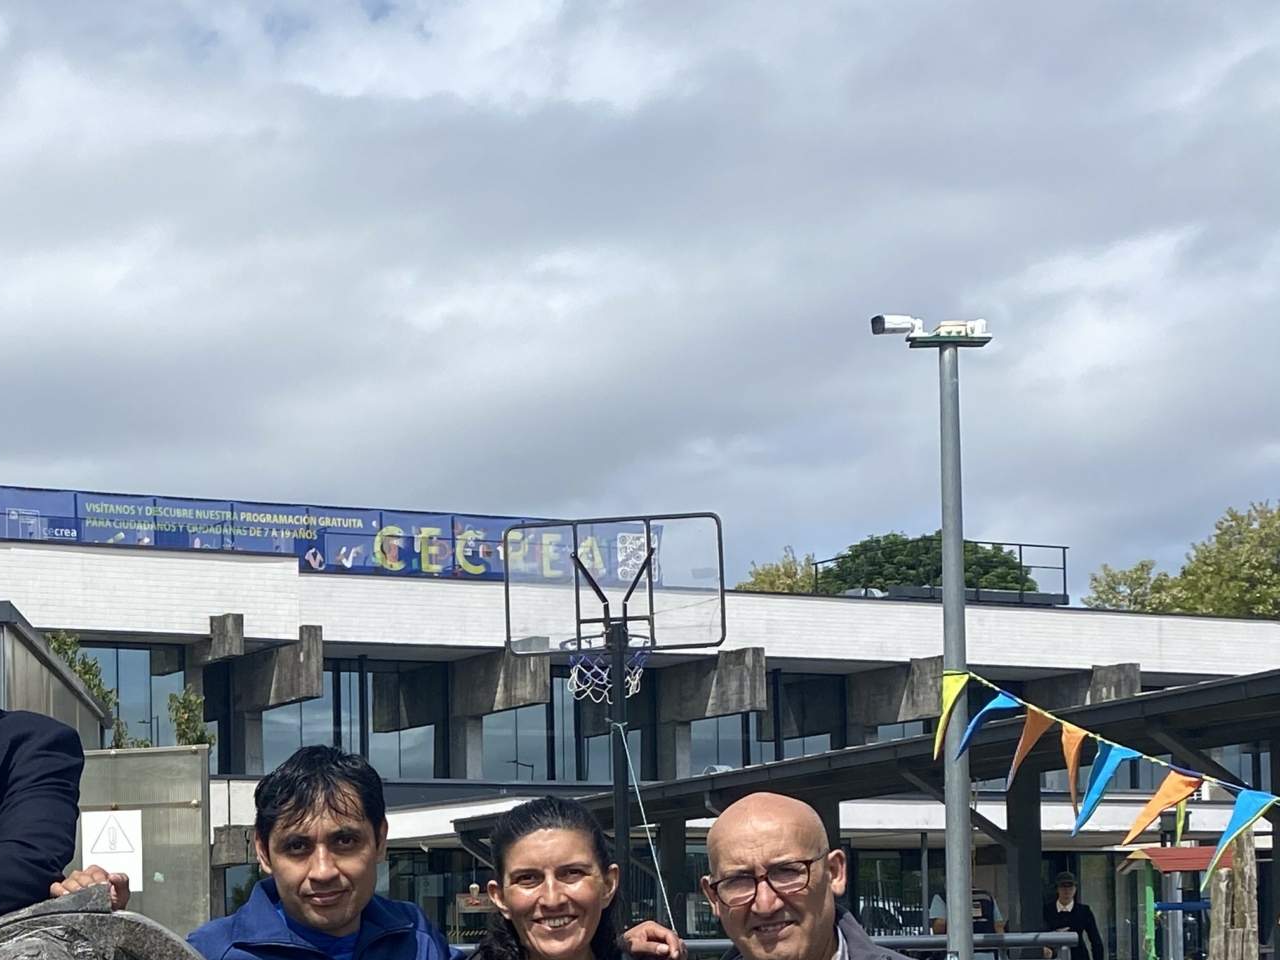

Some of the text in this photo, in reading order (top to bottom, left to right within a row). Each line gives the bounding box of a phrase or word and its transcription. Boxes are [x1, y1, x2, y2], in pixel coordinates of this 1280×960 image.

[85, 502, 363, 528] VISÍTANOS Y DESCUBRE NUESTRA PROGRAMACIÓN GRATUITA
[43, 527, 77, 537] cecrea
[86, 518, 318, 540] PARA CIUDADANOS Y CIUDADANAS DE 7 A 19 AÑOS
